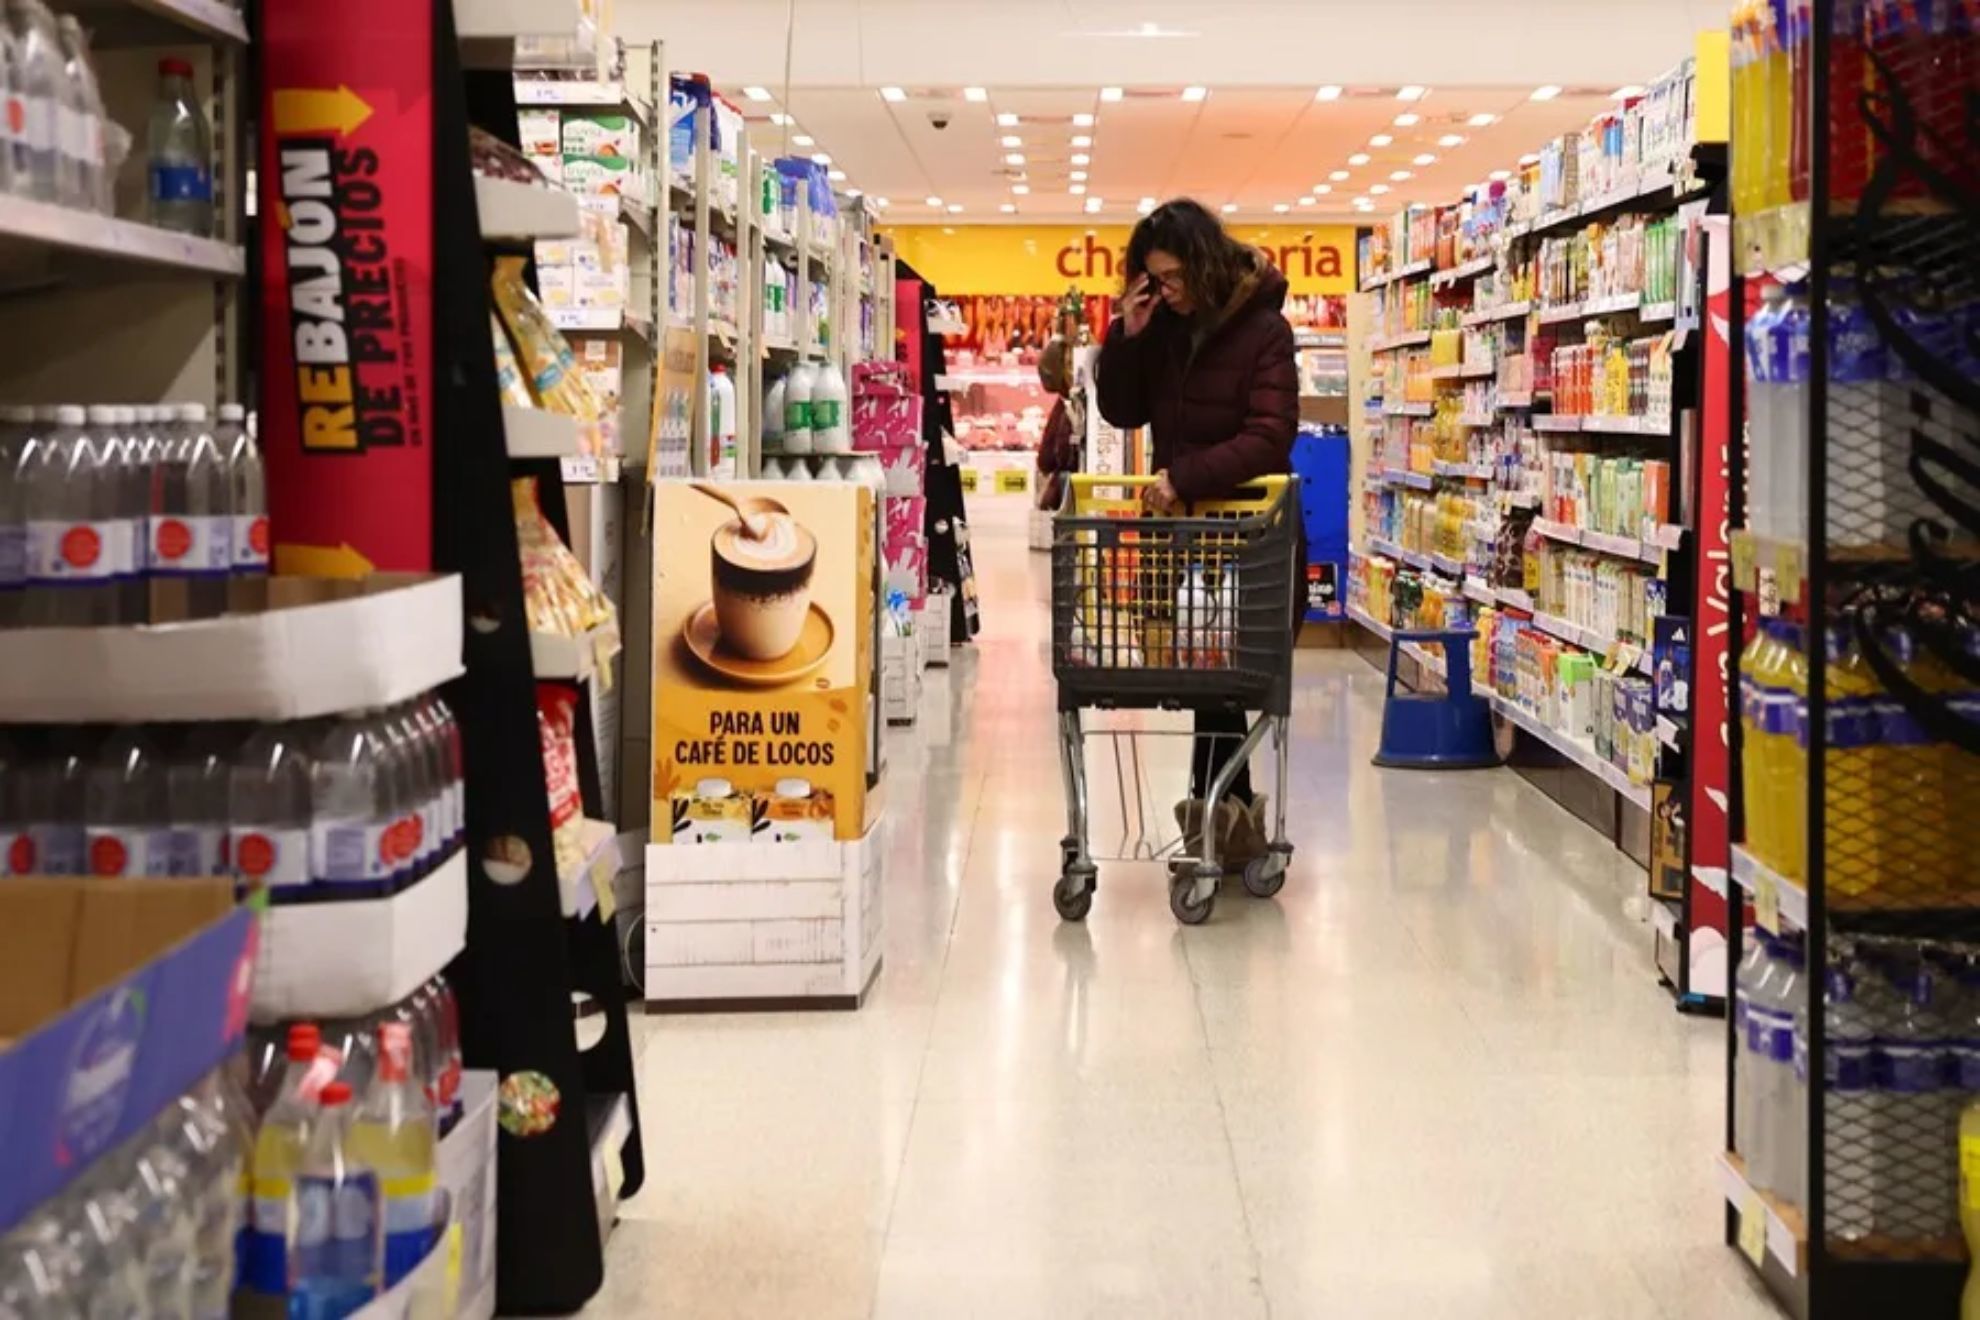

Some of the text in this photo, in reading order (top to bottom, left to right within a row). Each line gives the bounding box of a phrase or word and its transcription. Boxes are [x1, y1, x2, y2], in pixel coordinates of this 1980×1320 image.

[276, 149, 359, 449] REBAJÓN
[335, 148, 405, 446] DE PRECIOS
[675, 735, 834, 764] CAFÉ DE LOCOS
[710, 710, 799, 735] PARA UN
